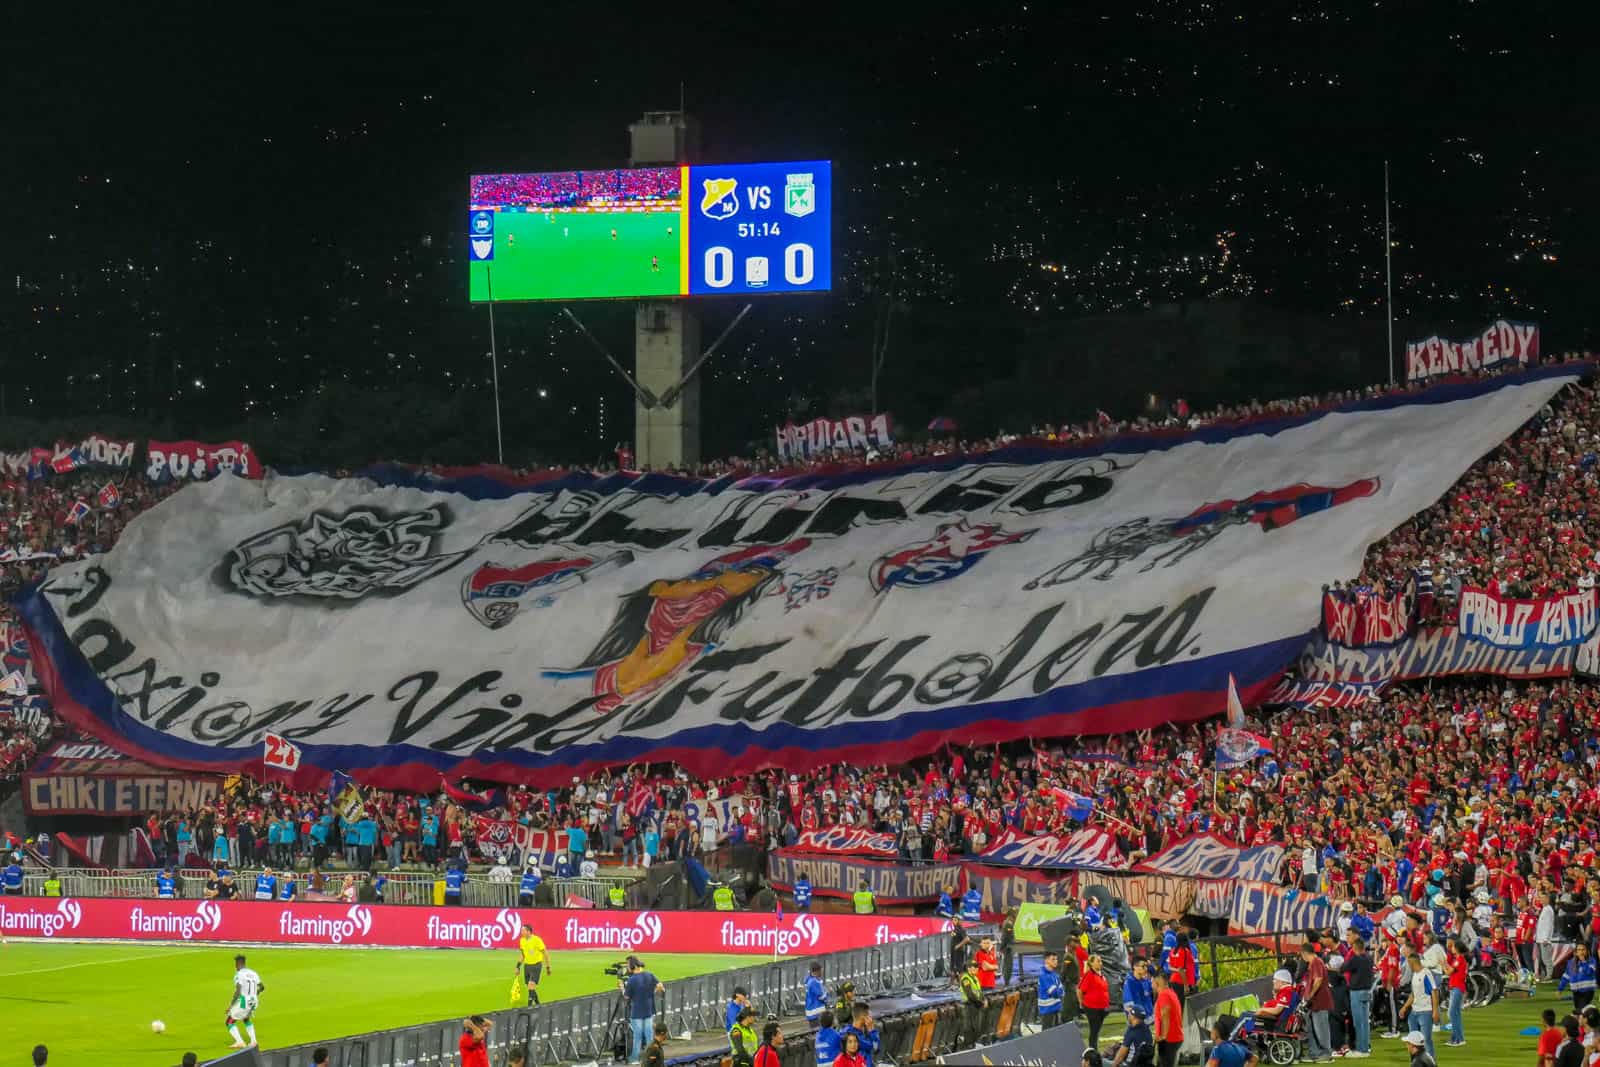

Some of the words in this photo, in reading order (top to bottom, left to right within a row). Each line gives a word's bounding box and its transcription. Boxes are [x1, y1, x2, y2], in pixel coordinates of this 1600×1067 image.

[746, 185, 772, 211] VS
[737, 221, 782, 238] 51:14
[704, 246, 734, 288] 0
[784, 243, 814, 285] 0
[1407, 319, 1536, 380] KENNEDY
[1460, 591, 1535, 646] PABLO
[30, 776, 105, 812] CHIKI
[769, 854, 788, 883] LA
[846, 865, 867, 892] DE
[0, 903, 65, 937] lamingo
[130, 908, 203, 939] flamingo
[279, 910, 354, 943] flamingo
[426, 915, 504, 948] flamingo
[565, 918, 644, 950] flamingo
[721, 920, 800, 955] flamingo
